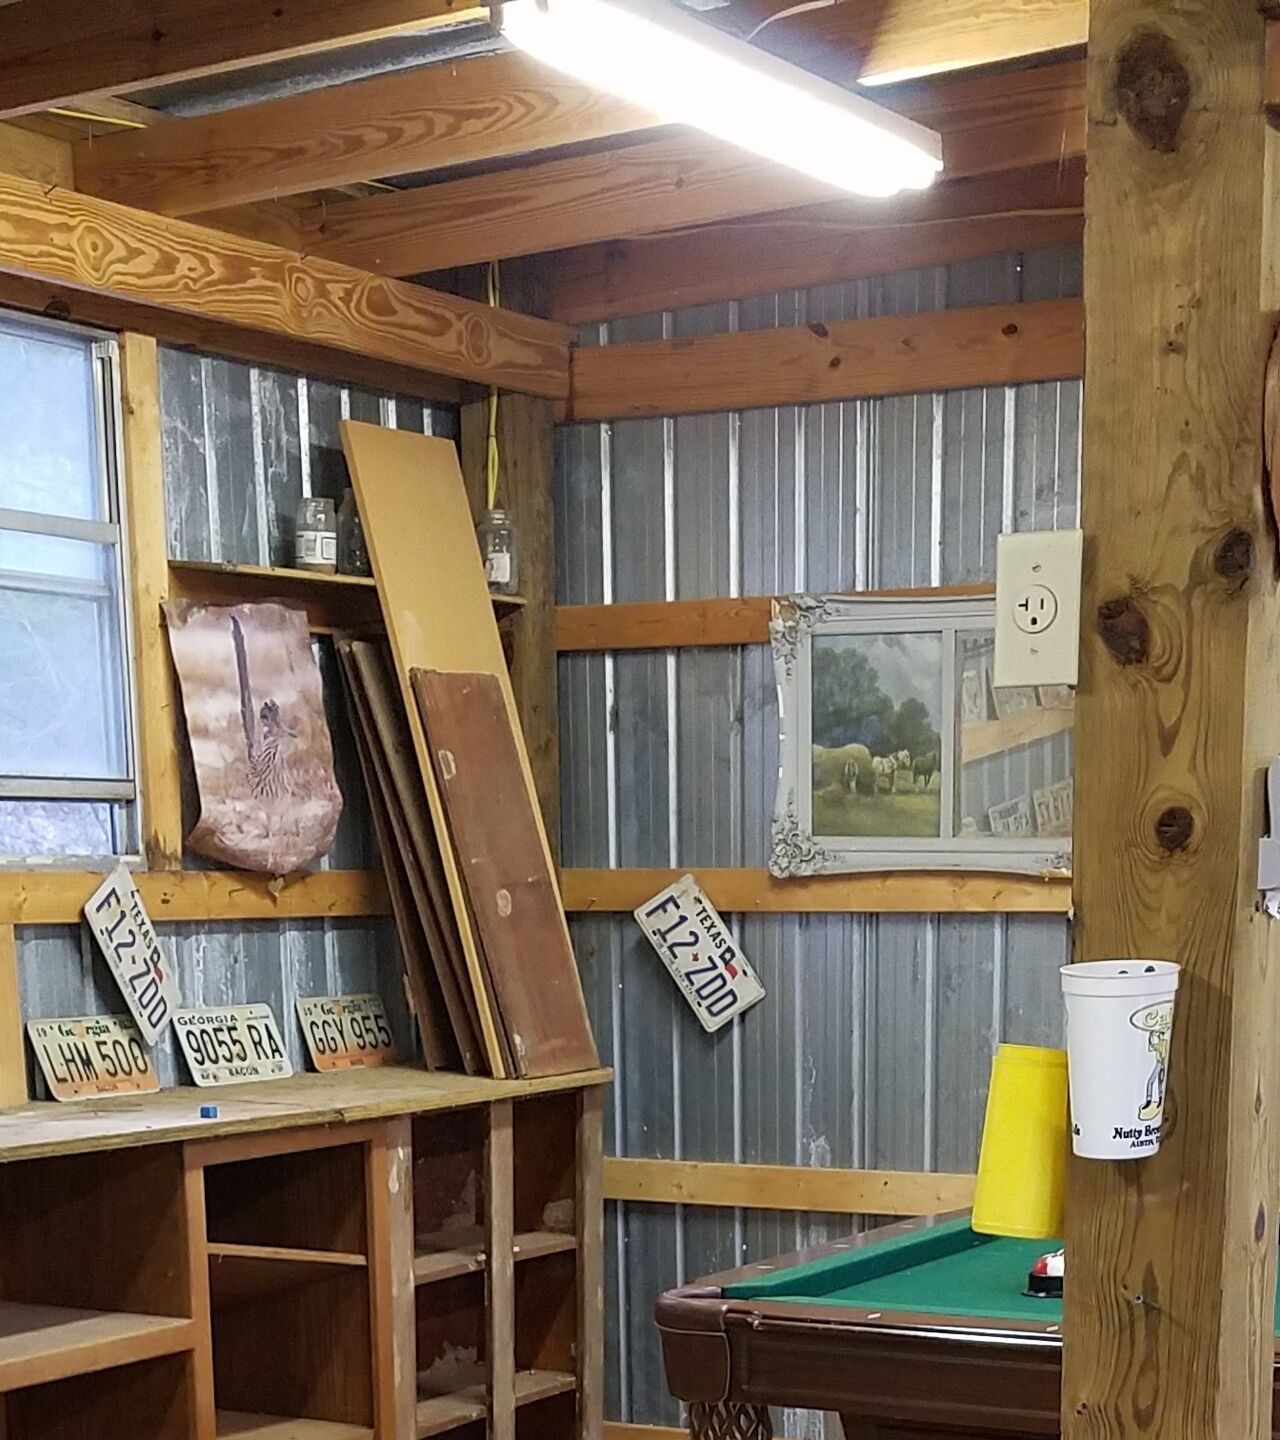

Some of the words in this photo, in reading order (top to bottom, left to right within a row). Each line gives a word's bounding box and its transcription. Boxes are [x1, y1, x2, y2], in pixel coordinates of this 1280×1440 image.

[96, 887, 136, 964] F12
[130, 902, 154, 950] TEXAS
[695, 907, 727, 950] TEXAS
[645, 894, 700, 960] F12
[684, 955, 738, 1018] ZDD
[177, 1014, 239, 1026] GEORGIA
[309, 1017, 349, 1055] GGY
[349, 1014, 392, 1050] 955
[42, 1041, 100, 1083] LHM
[186, 1025, 248, 1066] 9055
[246, 1023, 284, 1060] RA
[228, 1066, 260, 1077] BACON
[1112, 1125, 1143, 1142] Nutty
